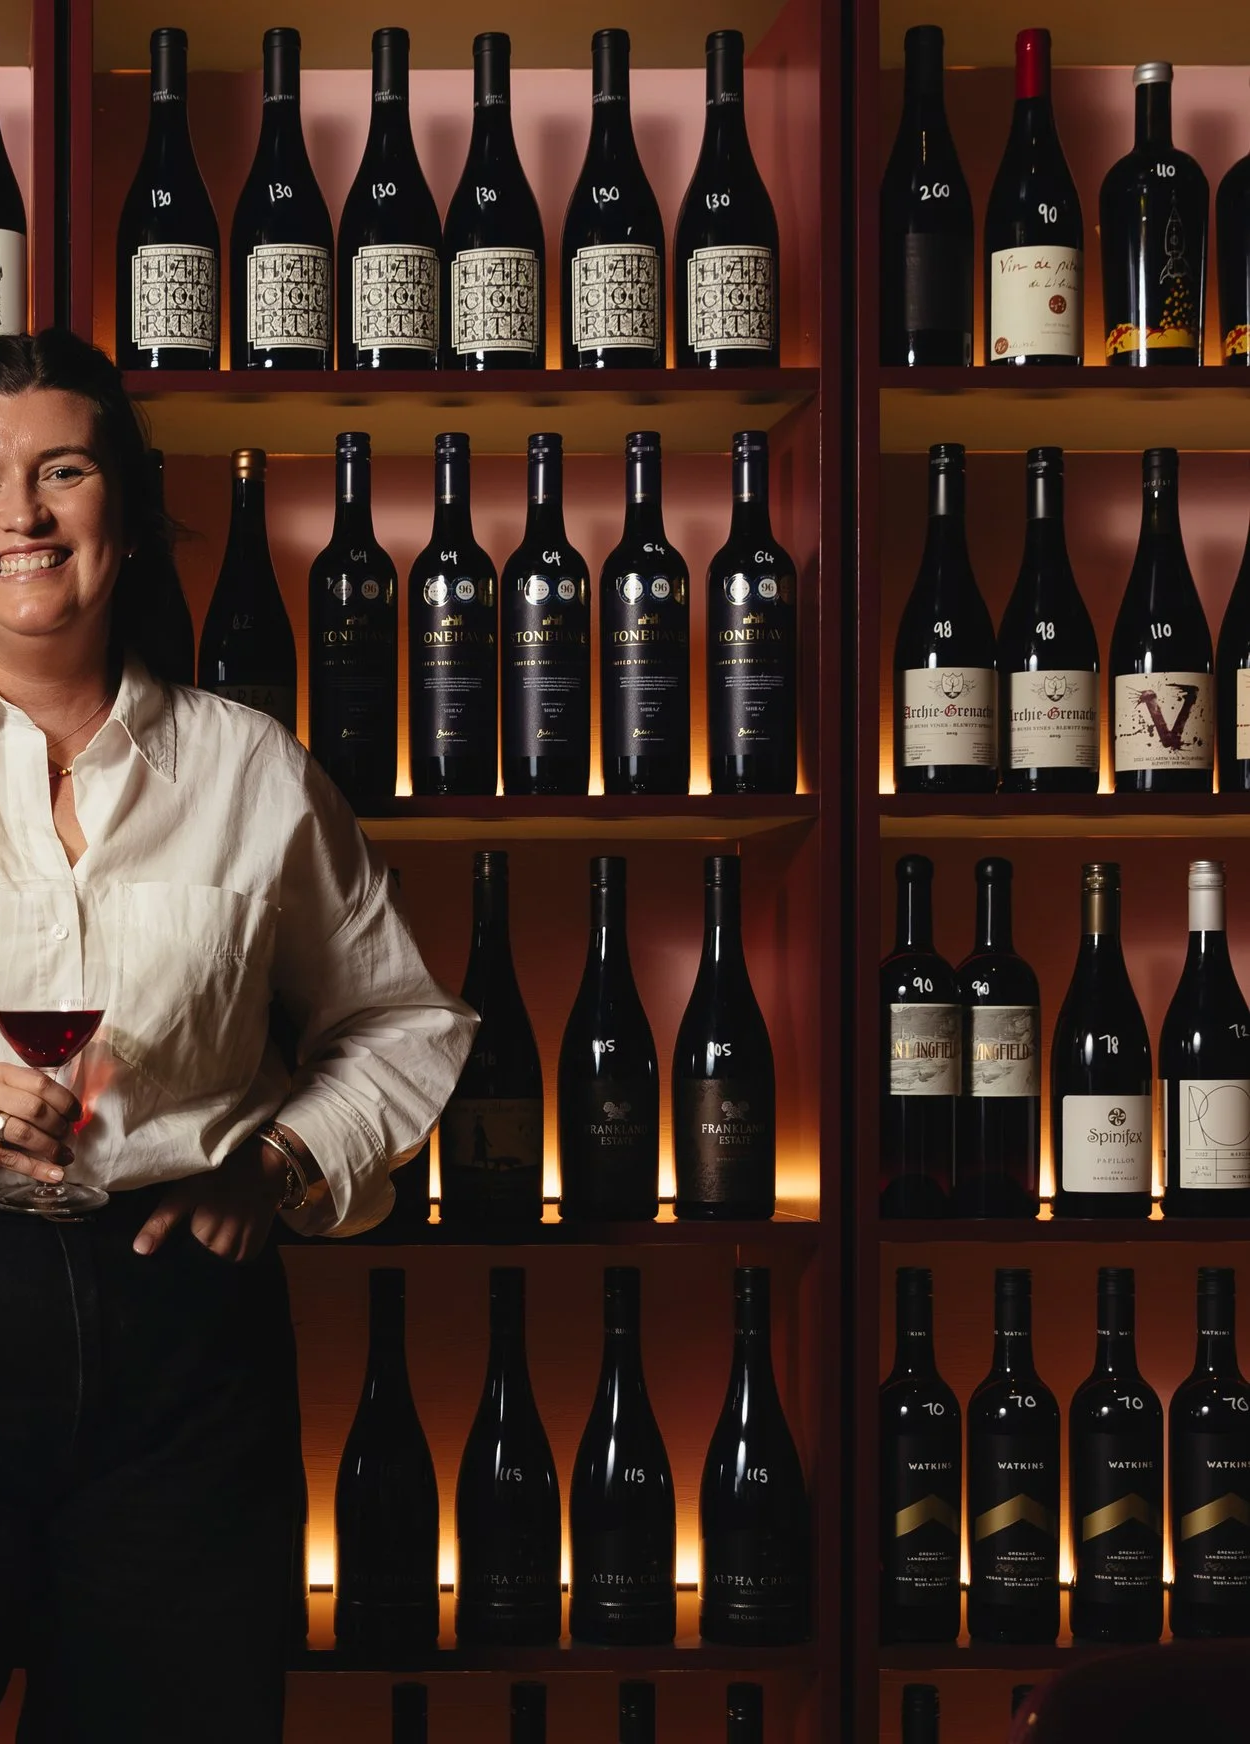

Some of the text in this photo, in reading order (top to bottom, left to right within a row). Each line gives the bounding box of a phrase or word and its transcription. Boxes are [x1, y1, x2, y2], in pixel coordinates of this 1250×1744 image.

[1156, 163, 1176, 178] 110
[152, 189, 171, 208] 130
[268, 183, 293, 202] 130
[372, 182, 397, 200] 130
[476, 187, 497, 206] 130
[592, 186, 620, 204] 130
[919, 182, 950, 201] 200
[706, 193, 730, 210] 130
[1038, 203, 1057, 224] 90
[350, 550, 367, 563] 64
[643, 543, 665, 555] 64
[440, 551, 458, 565] 64
[542, 550, 561, 566] 64
[754, 551, 774, 564] 64
[364, 584, 377, 593] 96
[458, 584, 472, 594] 96
[561, 584, 573, 593] 96
[654, 583, 667, 593] 96
[761, 582, 774, 592] 96
[934, 621, 952, 638] 98
[1036, 622, 1056, 640] 98
[1151, 623, 1172, 639] 110
[913, 977, 933, 993] 90
[972, 981, 990, 996] 90
[1098, 1034, 1119, 1054] 78
[719, 1135, 751, 1145] ESTATE
[1087, 1128, 1143, 1147] Spinifex
[922, 1402, 945, 1416] 70
[1008, 1395, 1037, 1408] 70
[1117, 1396, 1144, 1410] 70
[1222, 1397, 1249, 1411] 70
[908, 1462, 952, 1470] WATKINS
[997, 1462, 1045, 1470] WATKINS
[1108, 1460, 1153, 1469] WATKINS
[624, 1468, 646, 1483] 115
[746, 1468, 768, 1483] 115
